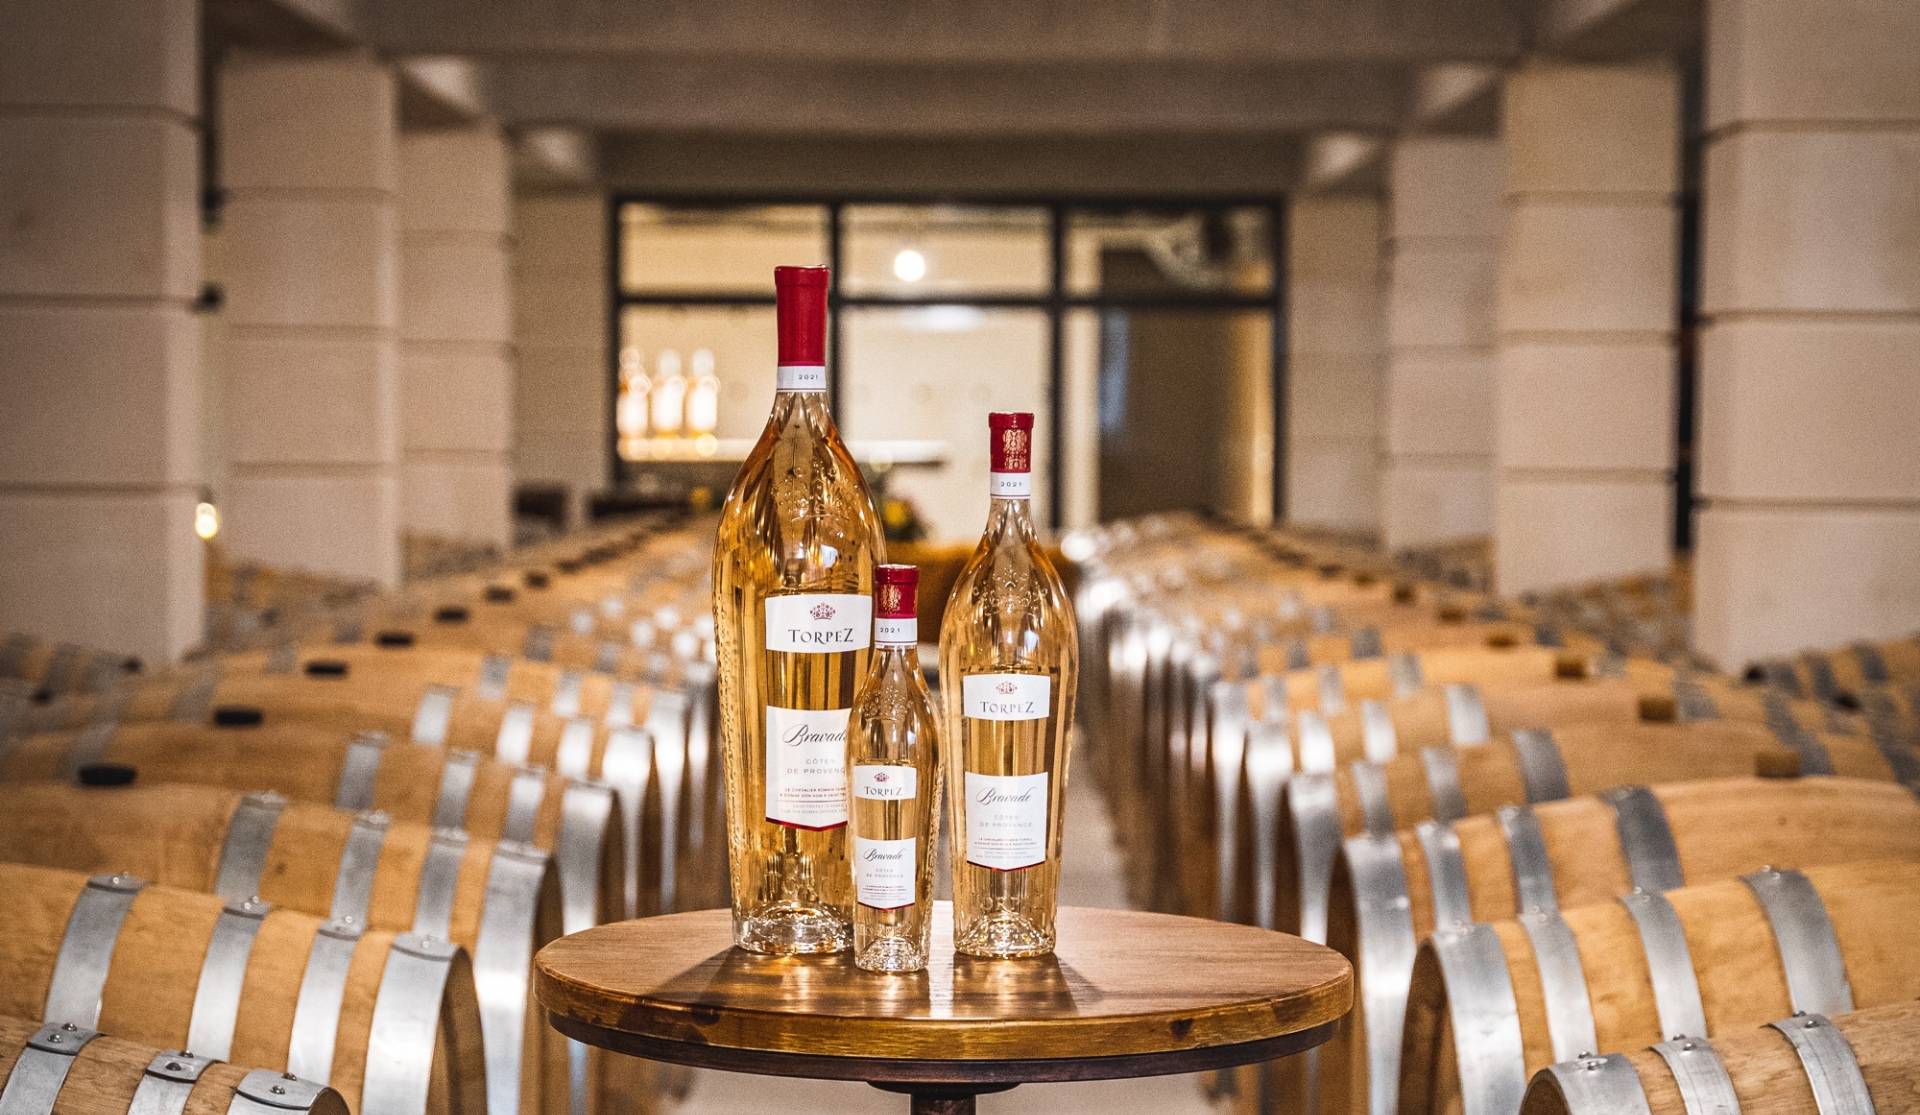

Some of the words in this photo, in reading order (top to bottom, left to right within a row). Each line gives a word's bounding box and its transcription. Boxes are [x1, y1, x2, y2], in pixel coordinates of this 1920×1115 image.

[788, 628, 854, 645] TORPEZ
[979, 701, 1035, 714] TORPEZ
[864, 786, 902, 797] TORPEZ
[976, 786, 1038, 805] Bravade
